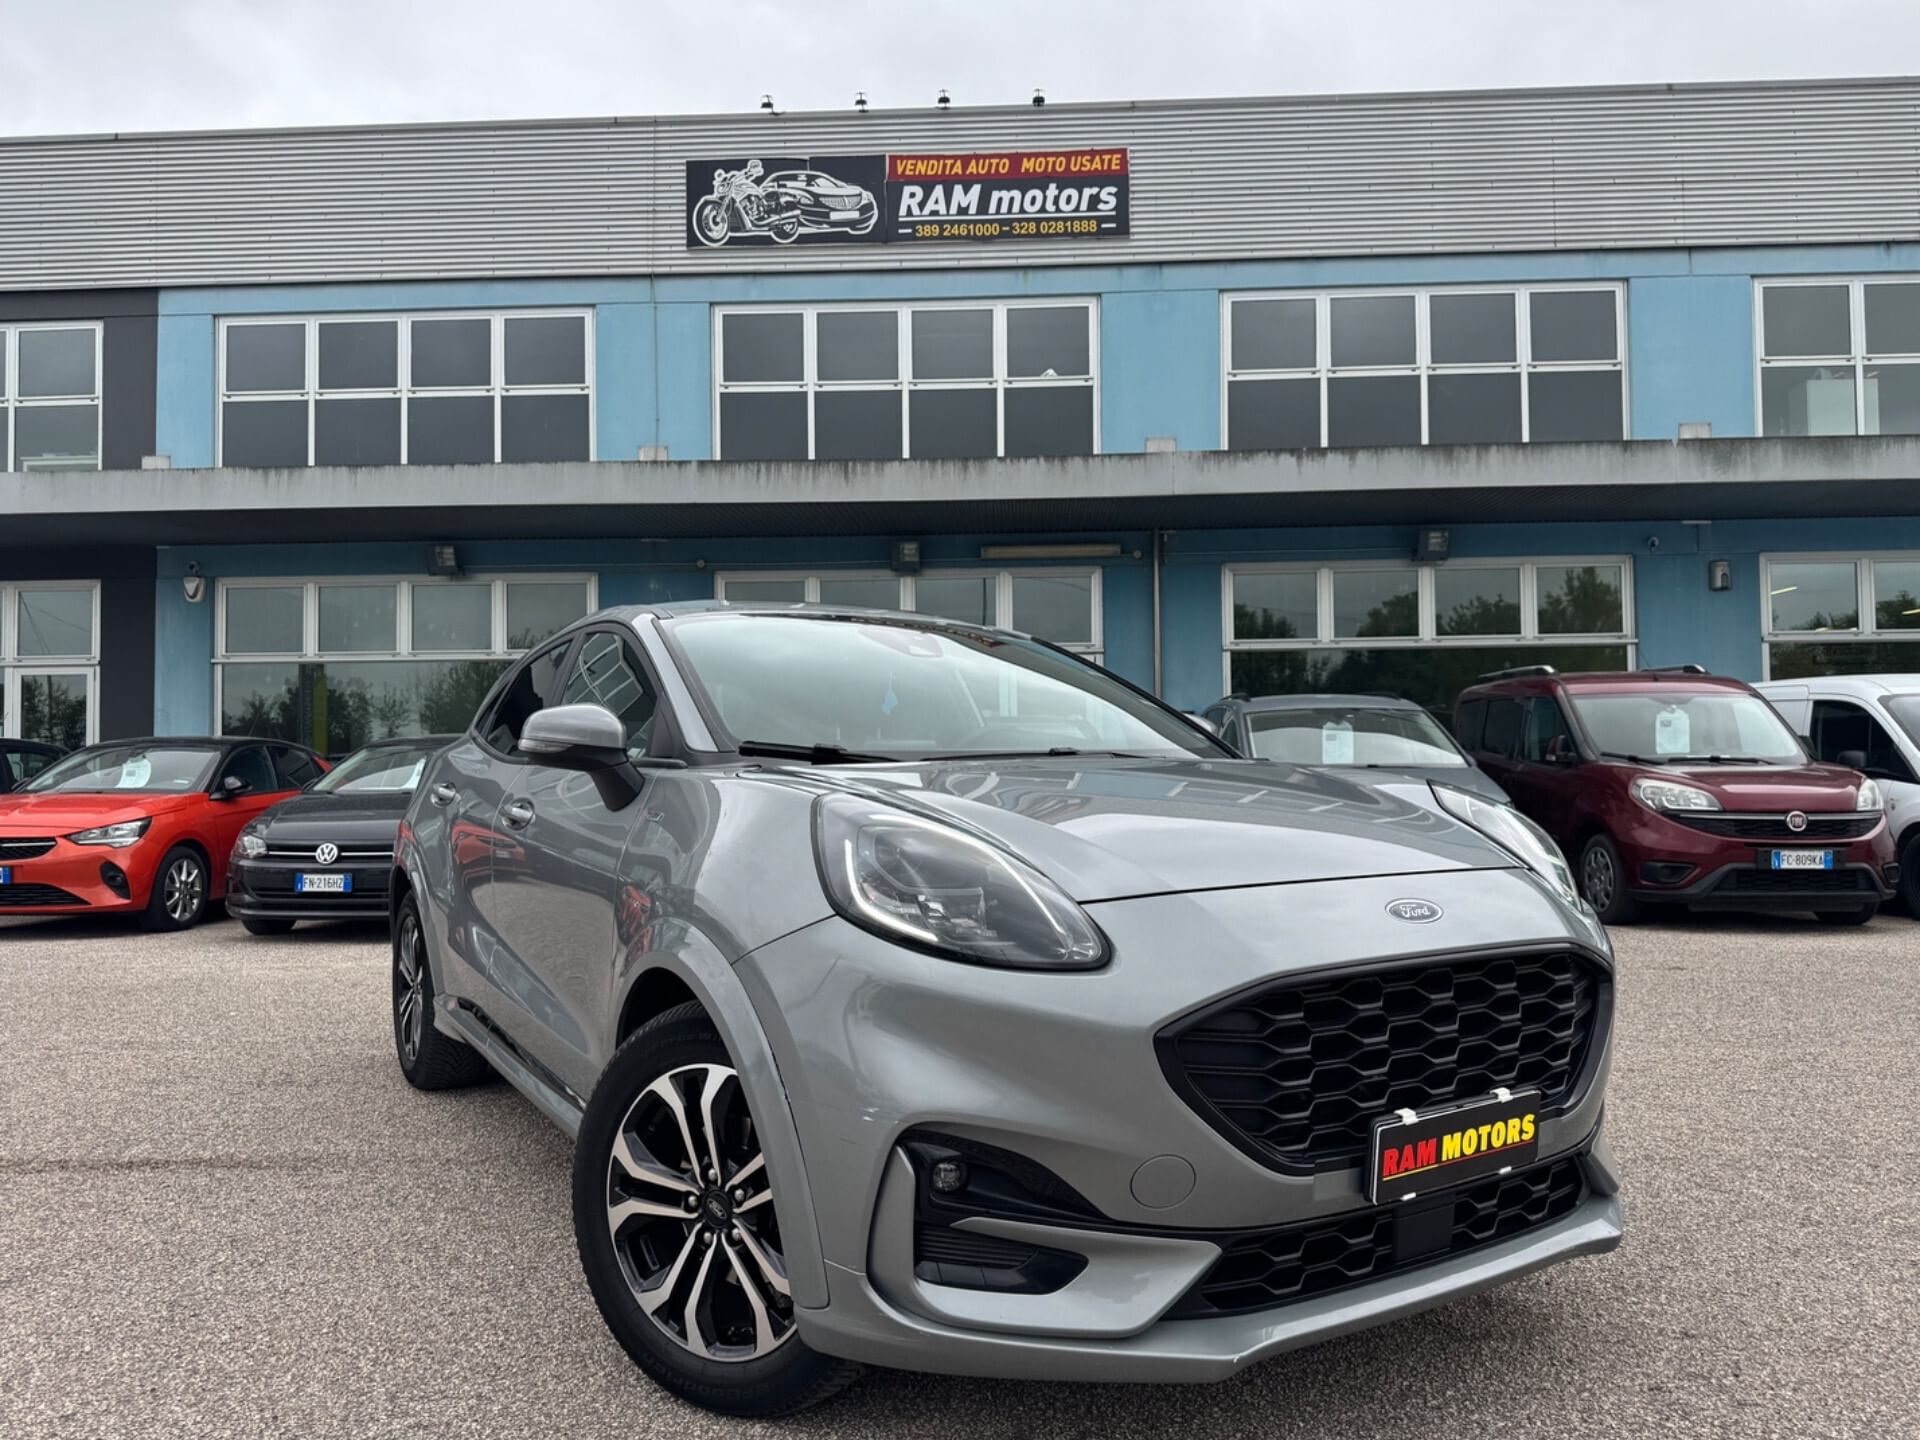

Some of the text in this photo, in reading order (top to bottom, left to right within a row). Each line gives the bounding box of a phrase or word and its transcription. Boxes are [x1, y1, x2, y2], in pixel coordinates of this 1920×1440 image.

[896, 154, 1122, 176] VENDITA AUTO MOTO USATE
[898, 183, 1118, 216] RAM motors
[915, 224, 940, 237] 389
[943, 222, 1000, 237] 2461000
[1012, 221, 1037, 235] 328
[1040, 220, 1098, 234] 0281888
[1399, 904, 1431, 918] Ford
[1382, 1113, 1536, 1177] RAM MOTORS
